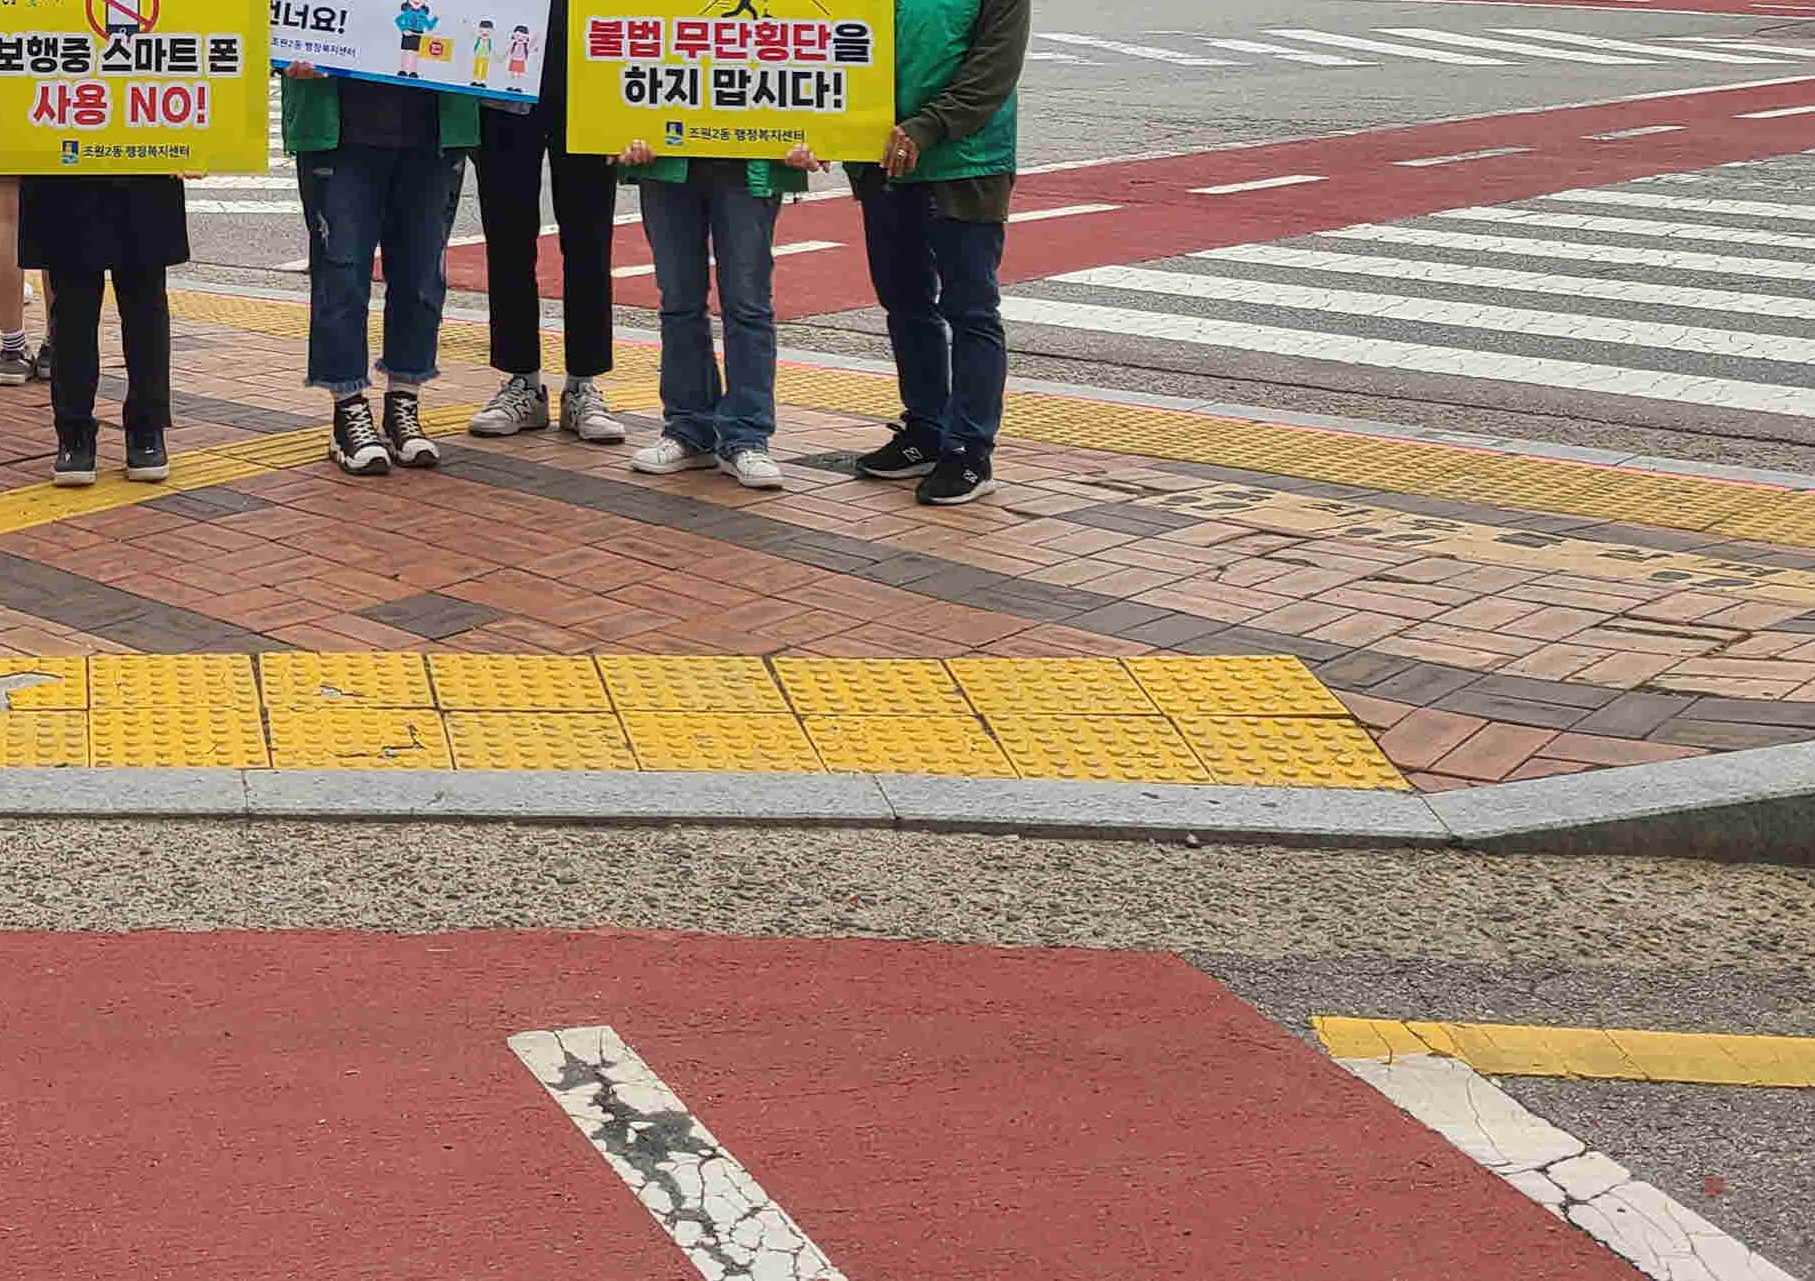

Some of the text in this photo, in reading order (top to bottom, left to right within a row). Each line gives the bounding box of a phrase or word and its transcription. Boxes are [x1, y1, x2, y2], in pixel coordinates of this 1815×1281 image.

[101, 37, 238, 73] 스마트폰
[304, 40, 356, 59] 행정복지센터
[588, 20, 871, 63] 불법 무단횡단을
[33, 82, 206, 125] 사용 NO!
[624, 66, 843, 109] 하지 맙시다!
[83, 144, 190, 159] 조원2동 행정복지센터
[688, 127, 805, 143] 조원2동 행정복지센터
